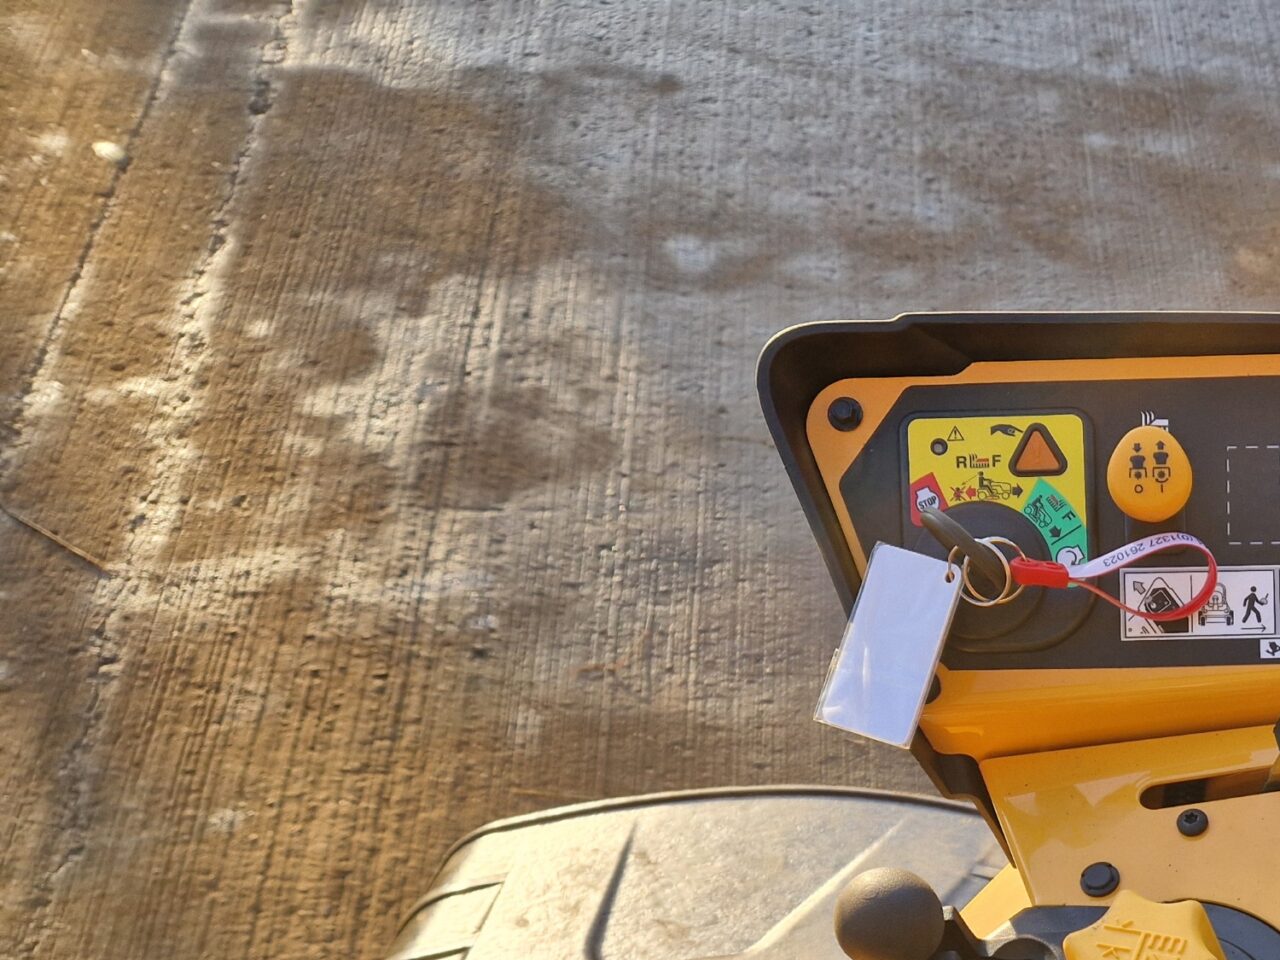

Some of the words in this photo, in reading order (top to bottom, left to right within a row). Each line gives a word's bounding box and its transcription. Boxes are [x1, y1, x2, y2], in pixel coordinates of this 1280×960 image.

[956, 456, 967, 468] R
[993, 454, 1002, 468] F
[919, 495, 937, 510] STOP
[1102, 543, 1145, 567] 261023
